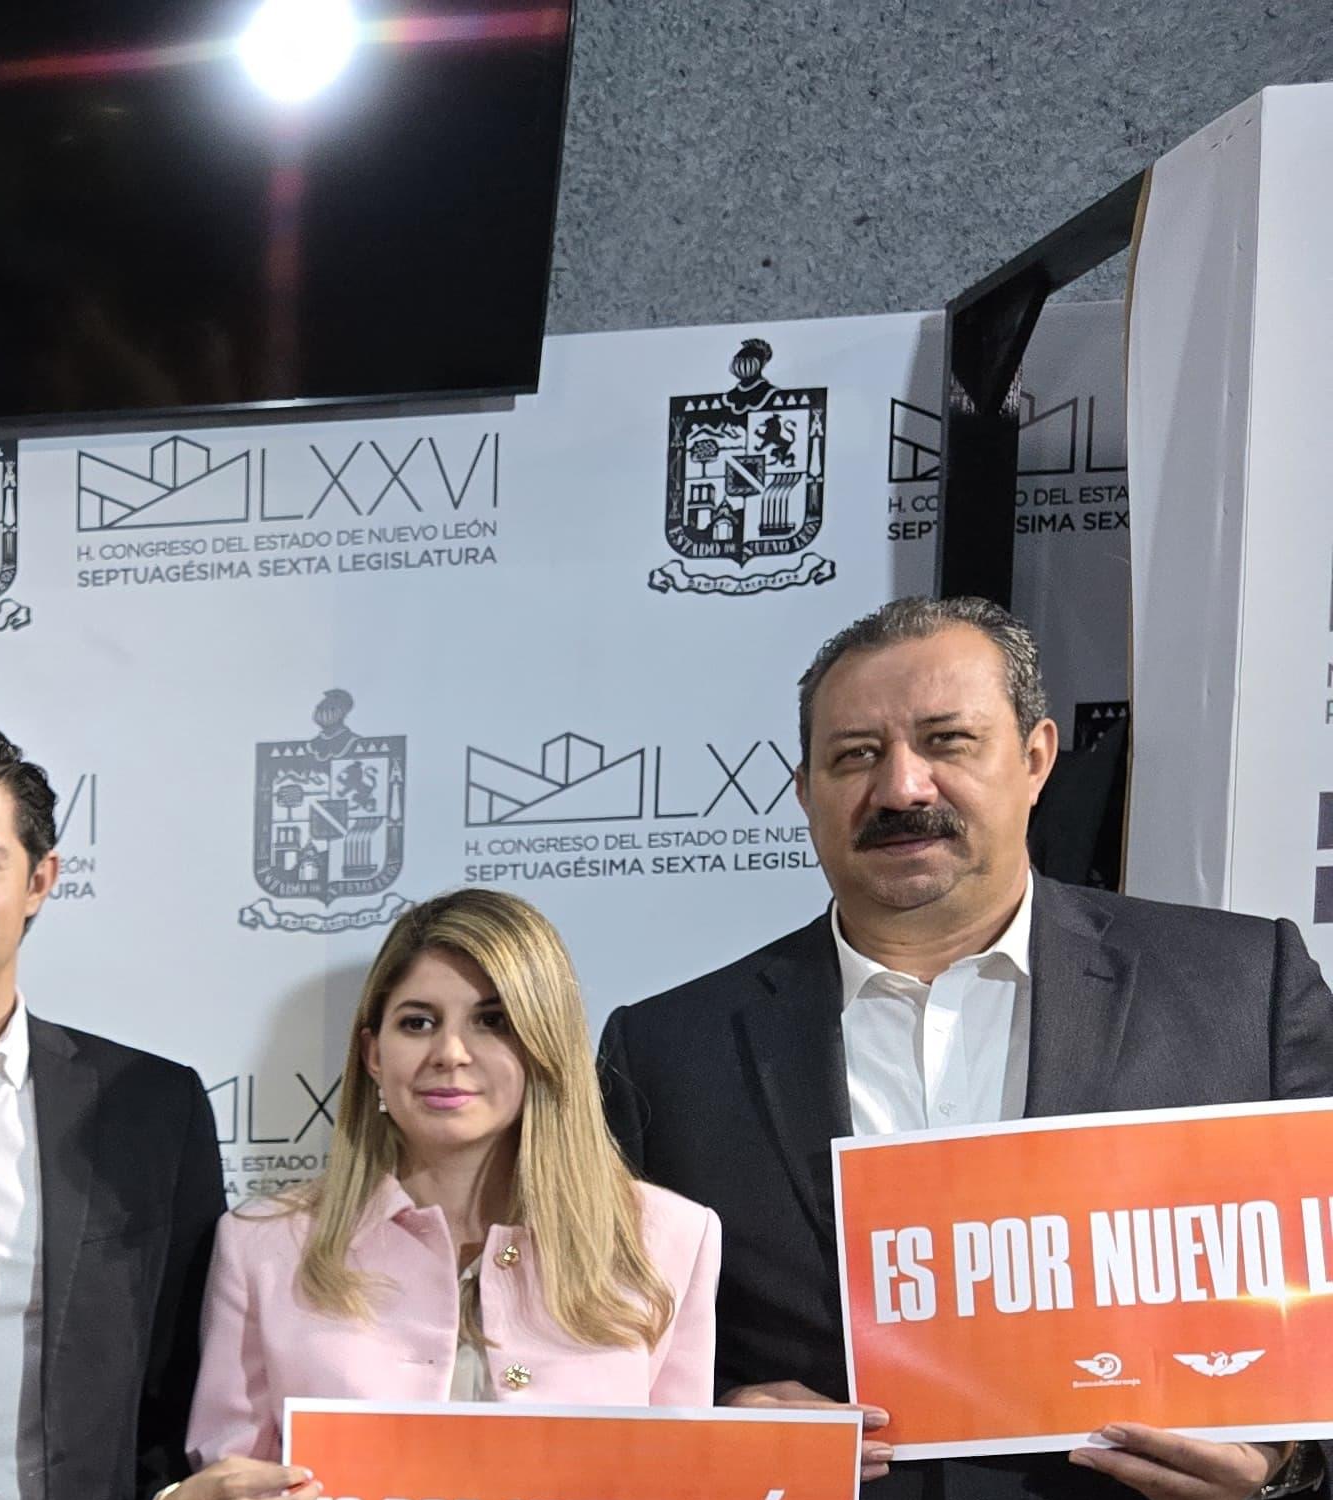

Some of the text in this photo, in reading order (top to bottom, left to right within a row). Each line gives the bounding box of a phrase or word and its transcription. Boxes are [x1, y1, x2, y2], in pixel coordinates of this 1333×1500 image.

[261, 433, 499, 522] LXXVI
[1034, 489, 1074, 506] DEL
[1080, 486, 1129, 504] ESTA
[1083, 511, 1129, 531] SEX
[76, 517, 497, 562] H. CONGRESO DEL ESTADO DE NUEVO LEÓN
[77, 546, 497, 588] SEPTUAGÉSIMA SEXTA LEGISLATURA
[488, 834, 598, 856] CONGRESO
[605, 833, 642, 850] DEL
[648, 830, 727, 849] ESTADO
[733, 829, 760, 845] DE
[766, 826, 809, 843] NUE
[465, 857, 643, 883] SEPTUAGÉSIMA
[652, 854, 726, 874] SEXTA
[242, 1155, 317, 1171] ESTADO
[871, 1226, 935, 1324] ES
[953, 1215, 1073, 1317] POR
[1090, 1200, 1286, 1307] NUEVO
